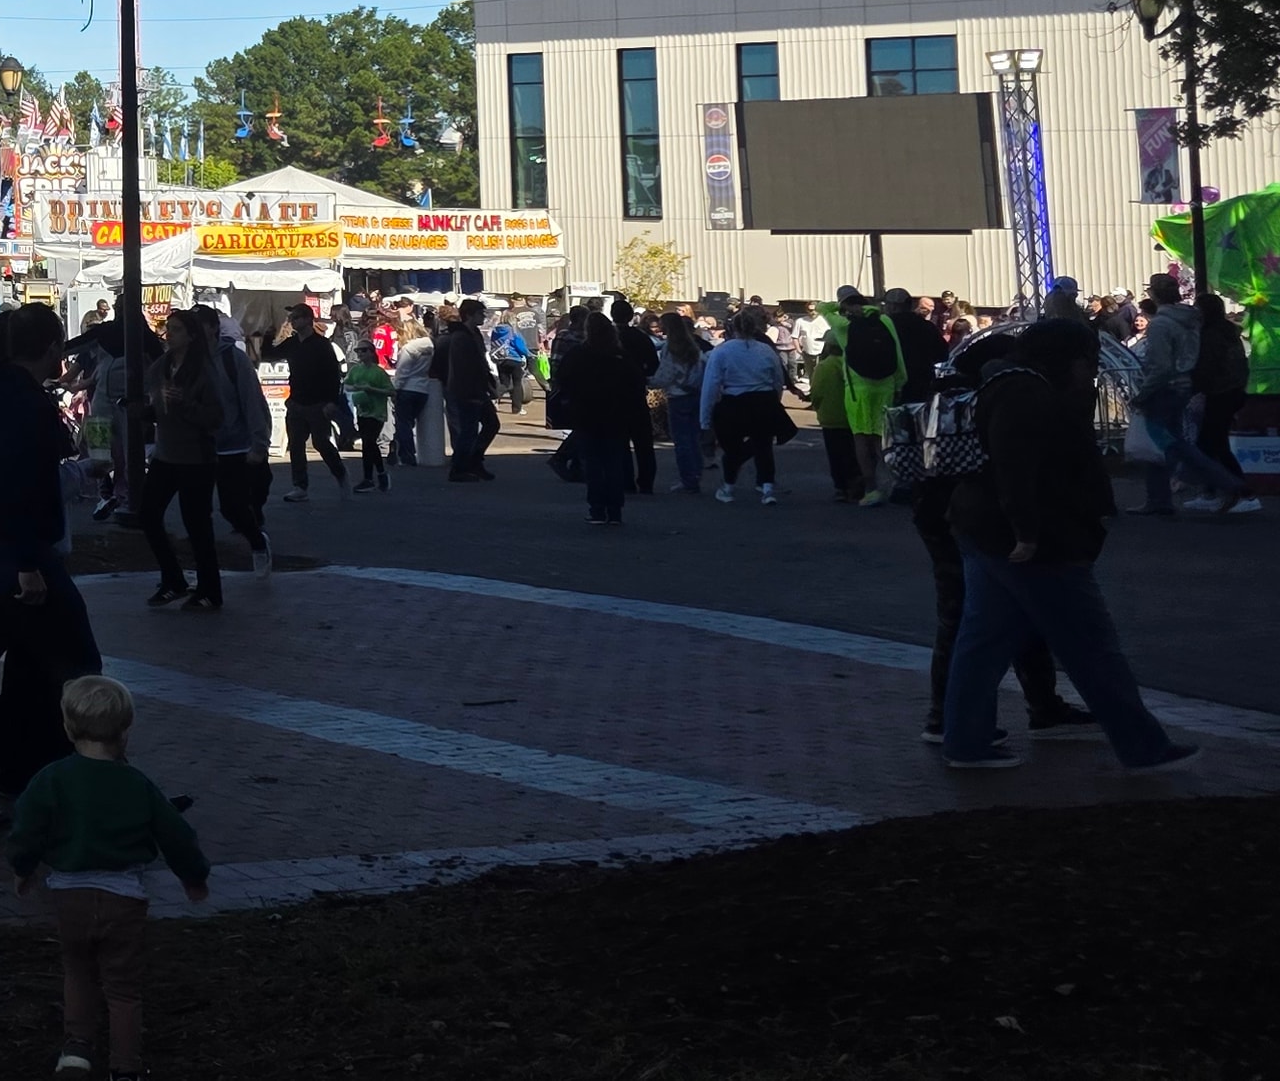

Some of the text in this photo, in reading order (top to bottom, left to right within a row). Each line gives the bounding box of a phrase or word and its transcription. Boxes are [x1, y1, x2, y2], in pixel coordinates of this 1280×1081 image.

[418, 215, 470, 231] BRINKLEY
[474, 215, 502, 231] CAFE
[202, 232, 339, 250] CARICATURES
[344, 234, 559, 250] TALIAN SAUSAGES POLISH SAUSAGES
[142, 285, 172, 304] OR YOU
